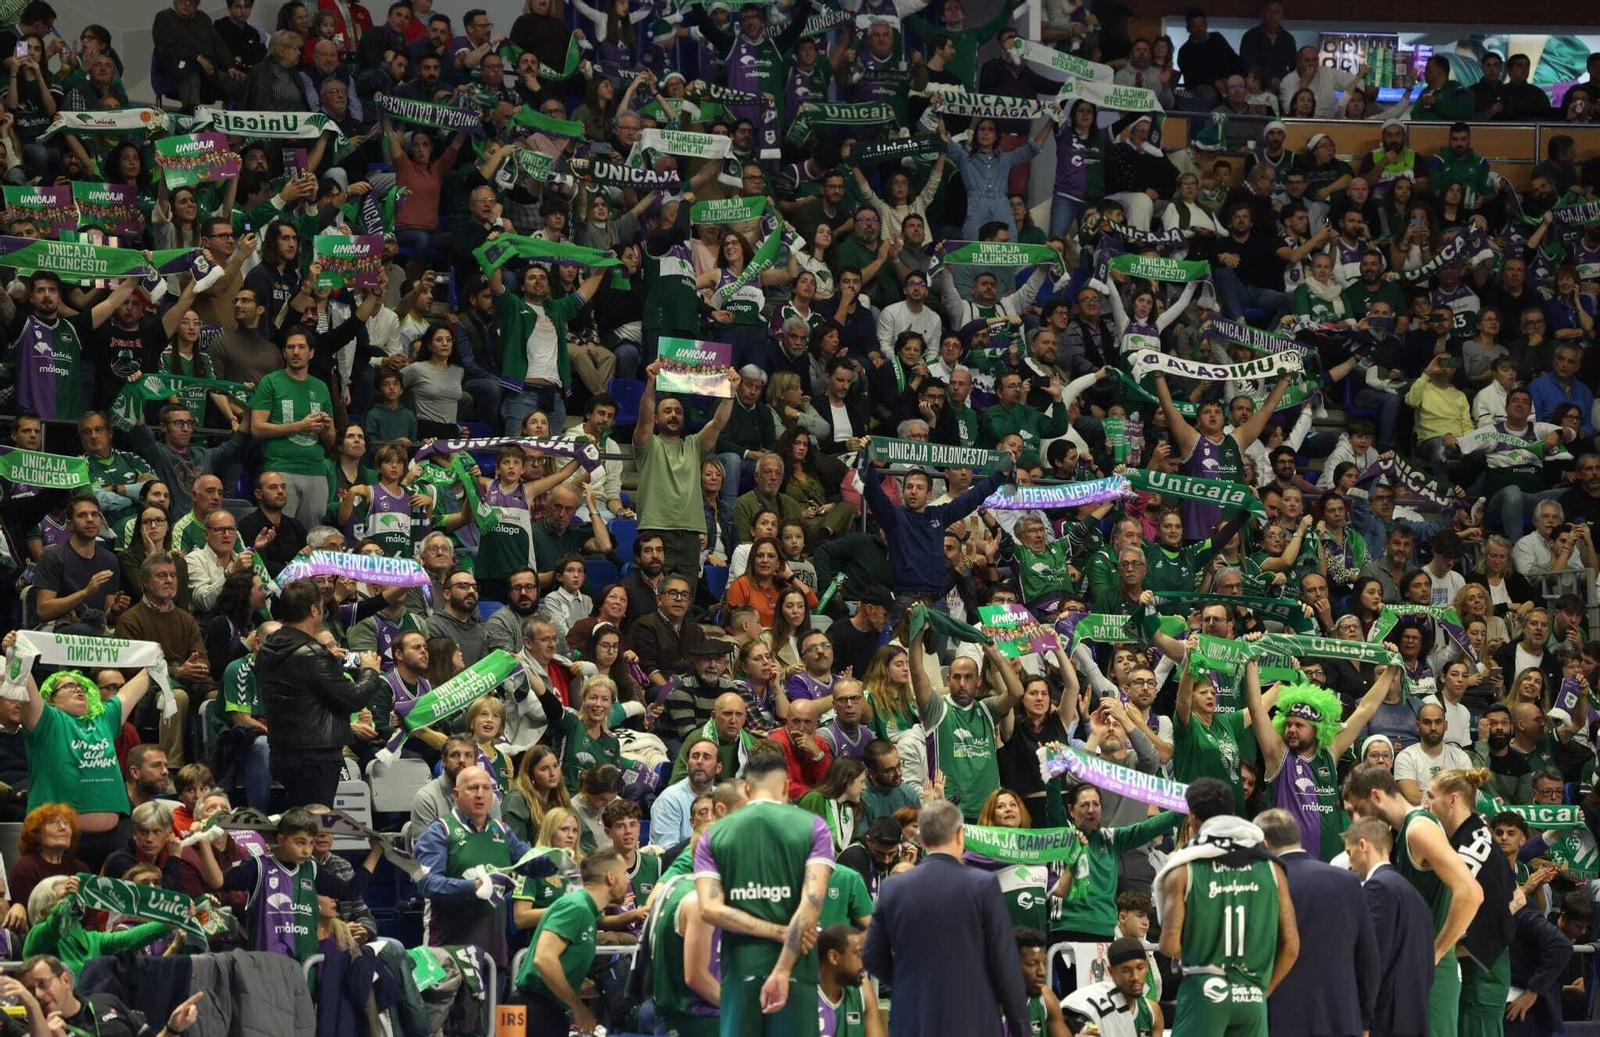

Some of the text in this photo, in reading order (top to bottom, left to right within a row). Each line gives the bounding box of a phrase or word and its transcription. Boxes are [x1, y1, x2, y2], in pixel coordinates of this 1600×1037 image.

[943, 91, 1033, 108] UNICAJA
[825, 103, 888, 120] Unicaj
[175, 140, 214, 154] UNICAJA
[594, 161, 681, 184] UNICAJA
[20, 195, 57, 205] UNICAJA
[89, 191, 124, 201] UNICAJA
[707, 198, 744, 210] UNICAJA
[701, 206, 751, 222] BALONCESTO
[48, 243, 97, 259] UNICAJA
[332, 244, 371, 255] UNICAJA
[979, 243, 1020, 254] UNICAJA
[37, 254, 107, 273] BALONCESTO
[972, 252, 1029, 263] BALONCESTO
[1139, 257, 1178, 268] UNICAJA
[1130, 263, 1187, 280] BALONCESTO
[675, 349, 717, 361] UNICAJA
[39, 366, 69, 376] málaga
[22, 453, 67, 470] UNICAJA
[888, 441, 988, 466] UNICAJA BALONCESTO
[11, 465, 80, 484] BALONCESTO
[1066, 480, 1104, 500] VERDE
[1148, 470, 1246, 508] Unicaja
[374, 556, 418, 576] VERDE
[991, 611, 1029, 624] UNICAJA
[1207, 641, 1240, 663] UNICAJ
[1310, 638, 1376, 658] Unicaja
[434, 667, 481, 699] UNICAJA
[431, 672, 497, 717] BALONCESTO
[1087, 756, 1158, 791] INFIERNO
[1302, 801, 1334, 813] málaga
[730, 882, 791, 902] málaga
[1224, 904, 1245, 957] 11
[501, 1012, 525, 1026] IRS
